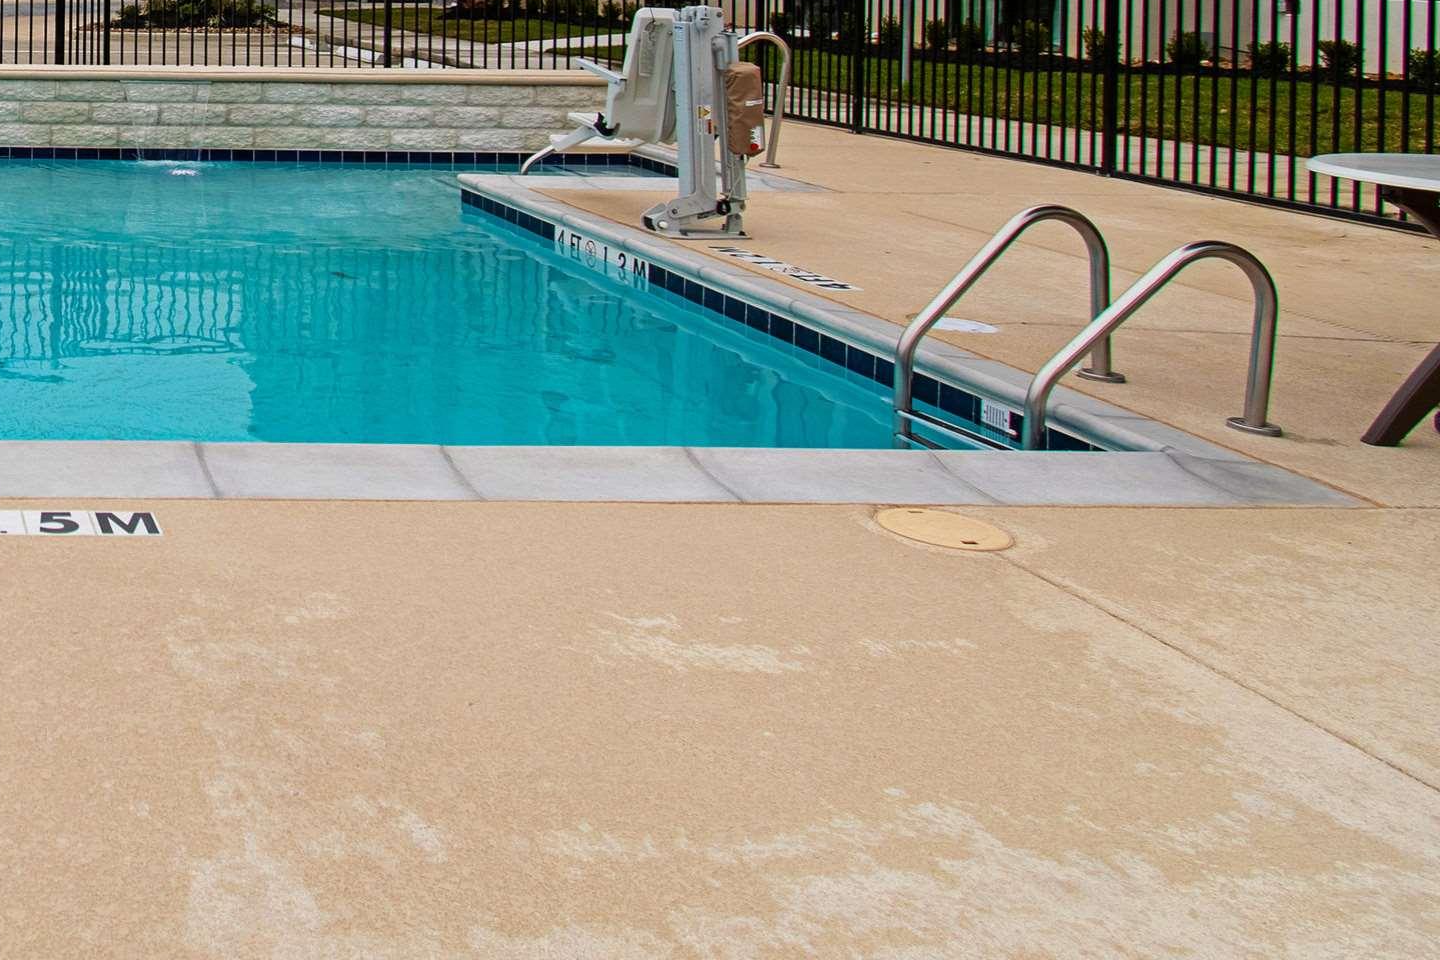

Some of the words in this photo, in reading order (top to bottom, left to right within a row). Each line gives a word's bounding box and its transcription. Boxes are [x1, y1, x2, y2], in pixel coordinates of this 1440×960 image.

[570, 233, 582, 251] FT
[633, 257, 646, 279] M
[95, 512, 160, 534] M
